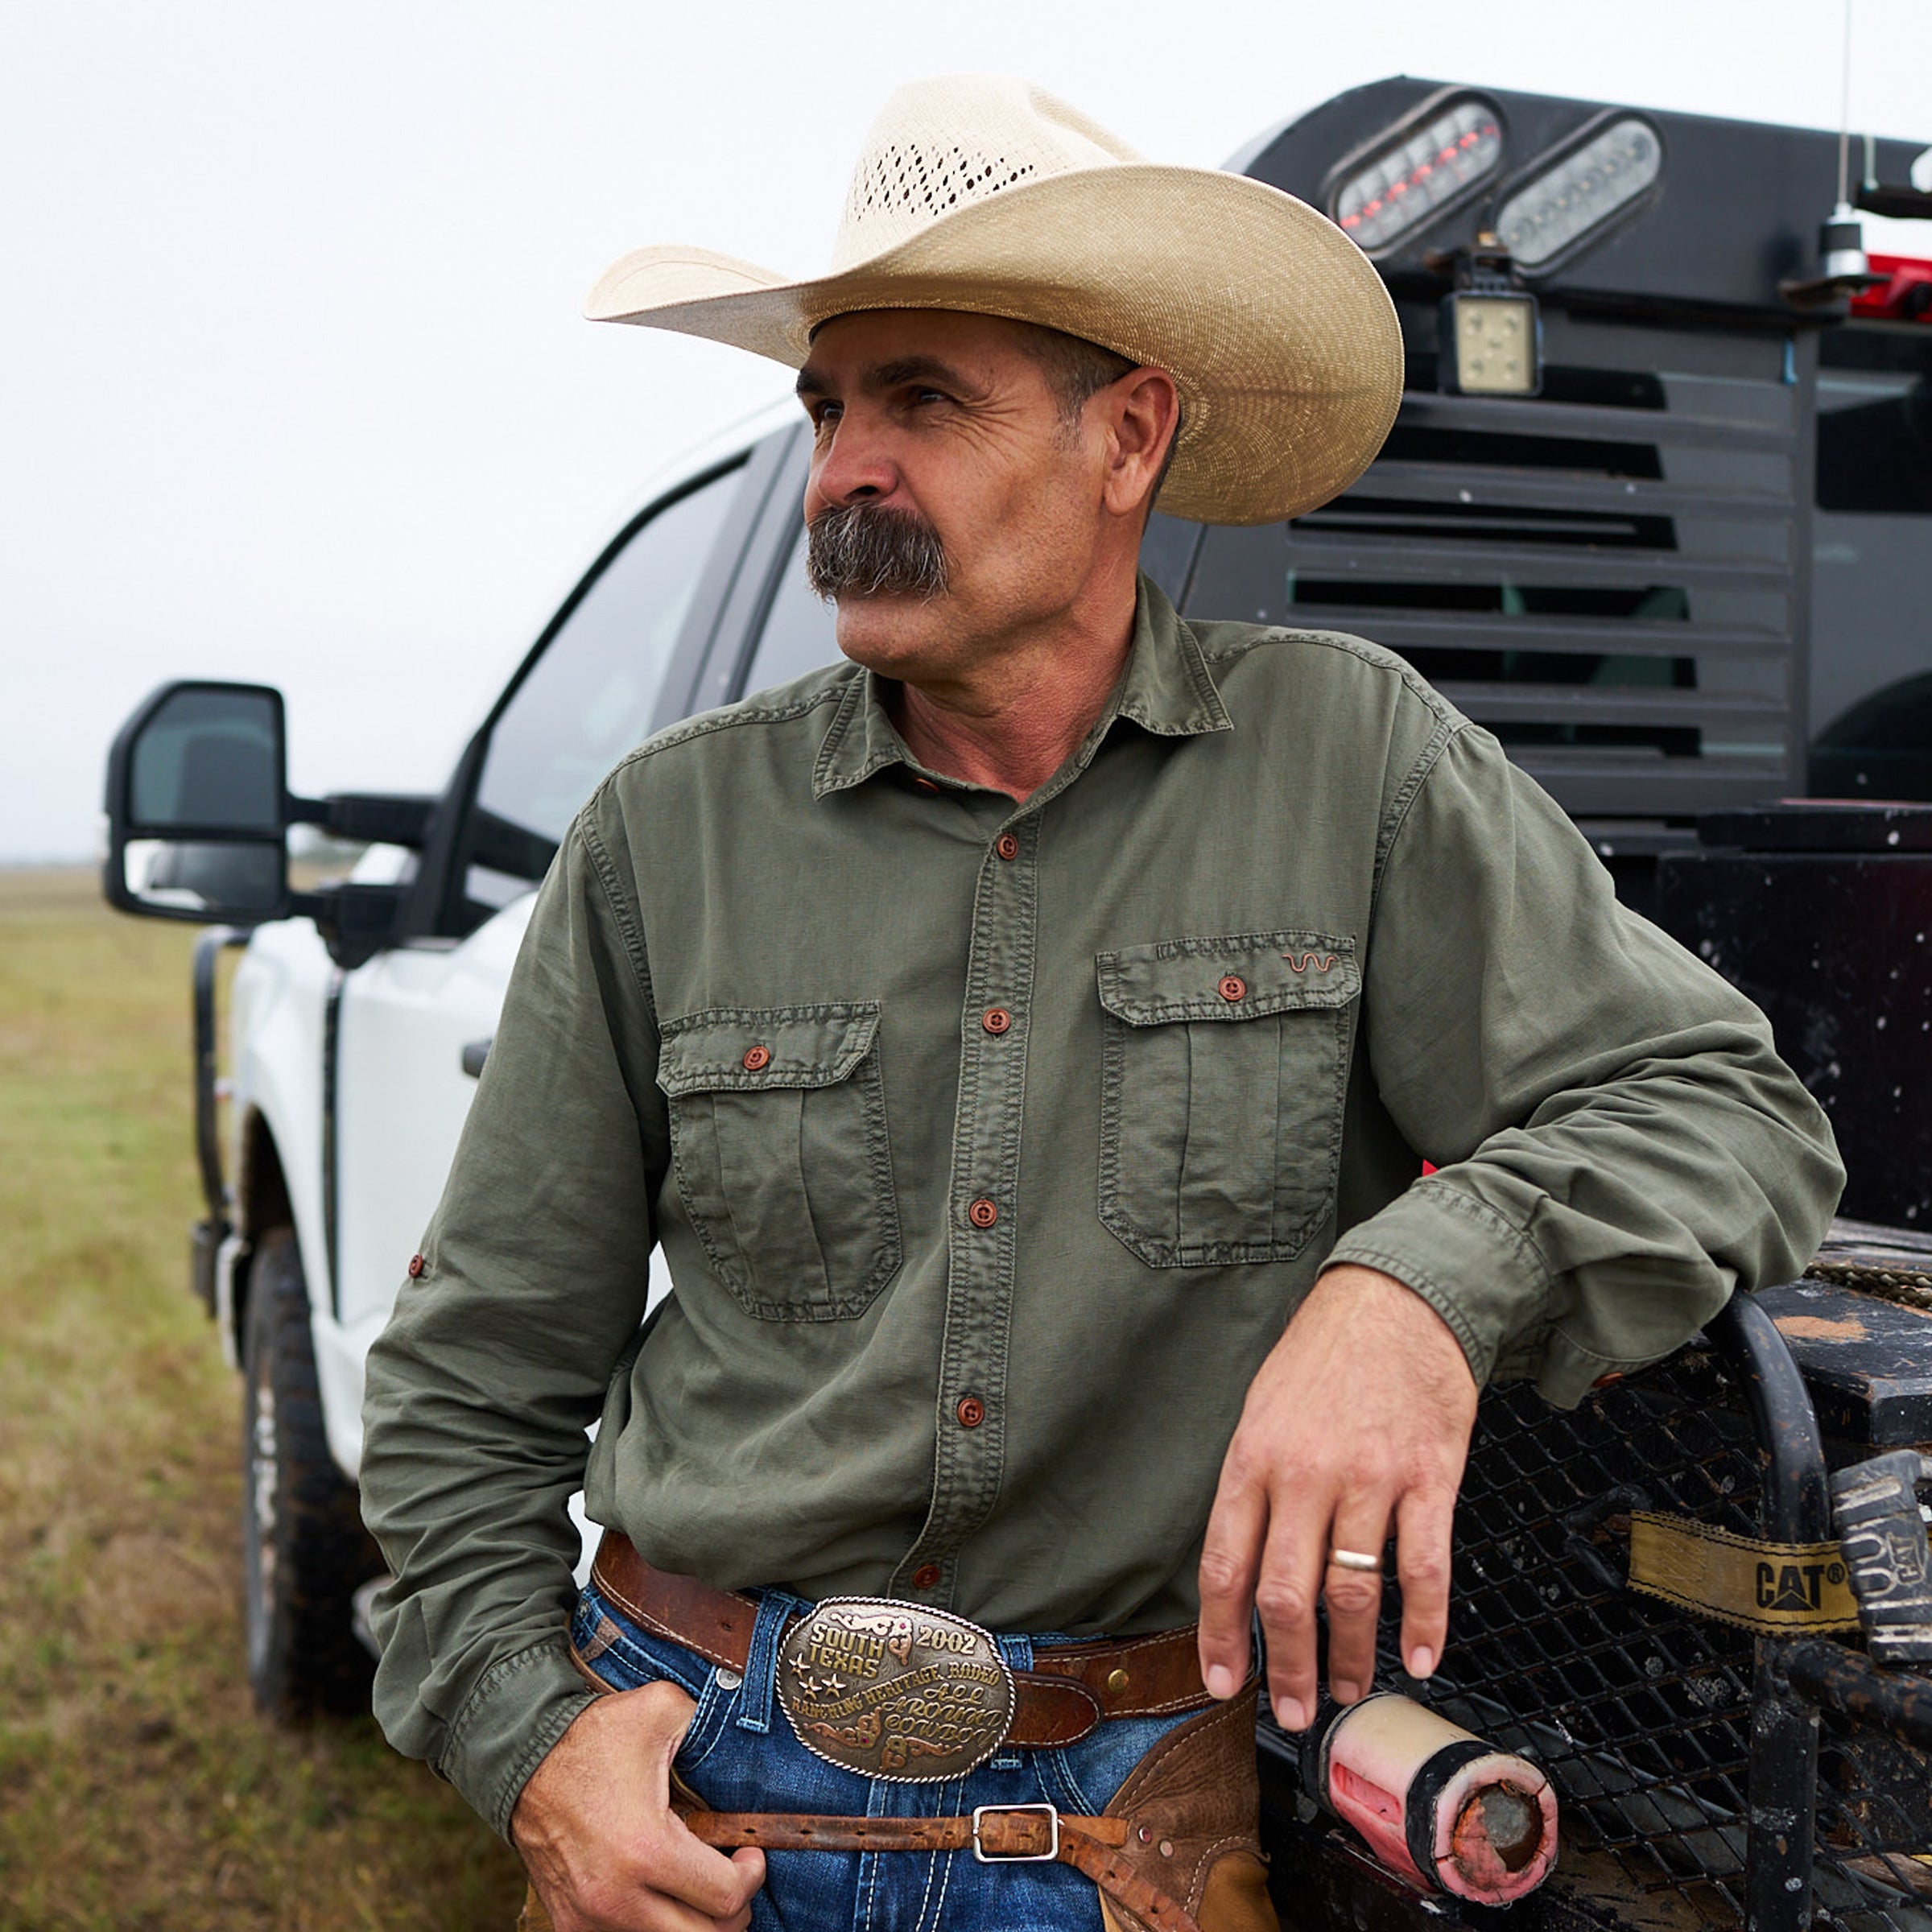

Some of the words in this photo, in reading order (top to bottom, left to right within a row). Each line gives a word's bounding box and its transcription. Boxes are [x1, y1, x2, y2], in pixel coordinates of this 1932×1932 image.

[810, 1623, 885, 1659] SOUTH
[915, 1625, 977, 1654] 2002
[810, 1642, 880, 1678] TEXAS
[791, 1692, 863, 1719] RANCHING
[861, 1663, 944, 1706] HERITAGE
[947, 1662, 1000, 1686] RODEO
[923, 1682, 984, 1705] ALL
[881, 1696, 1004, 1728] AROUND
[884, 1714, 997, 1748] COWBOY
